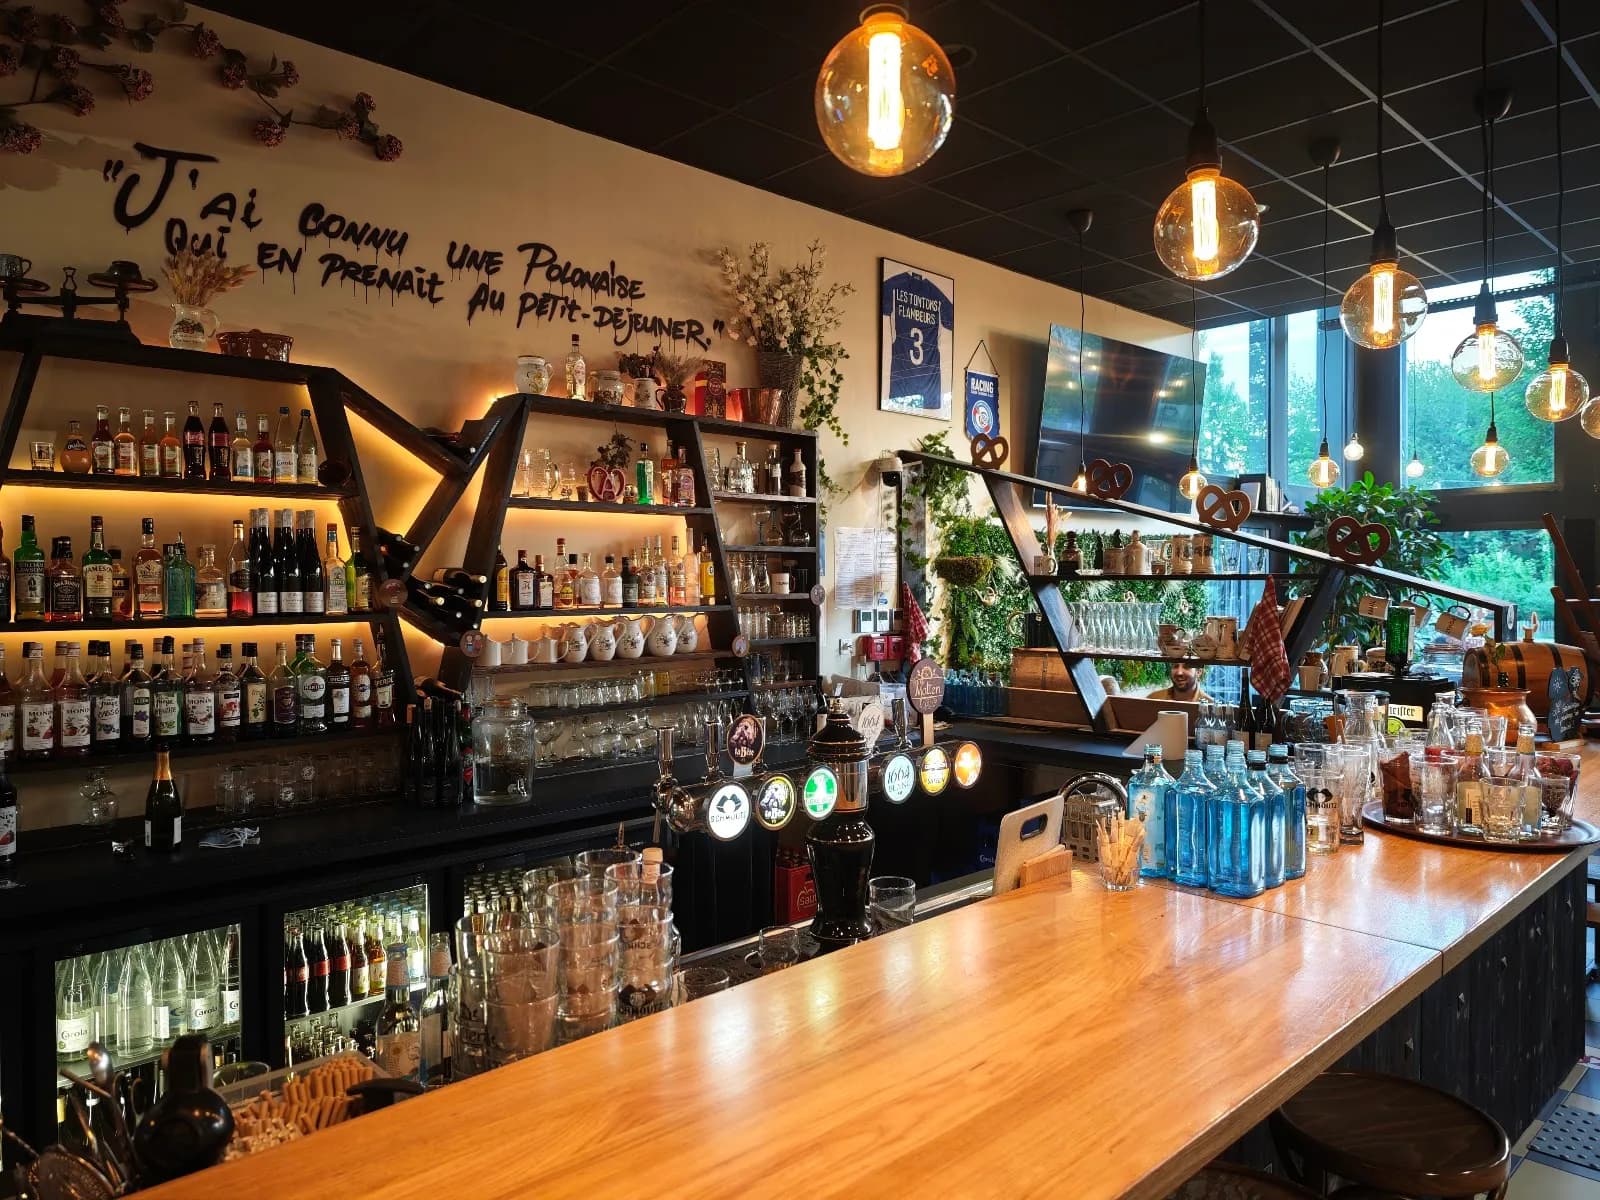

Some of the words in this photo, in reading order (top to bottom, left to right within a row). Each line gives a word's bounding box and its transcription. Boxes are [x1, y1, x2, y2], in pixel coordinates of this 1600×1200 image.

[257, 242, 302, 275] EN
[446, 241, 503, 275] UNE
[909, 327, 924, 366] 3
[970, 378, 994, 393] RACING
[86, 565, 112, 573] JAMESON
